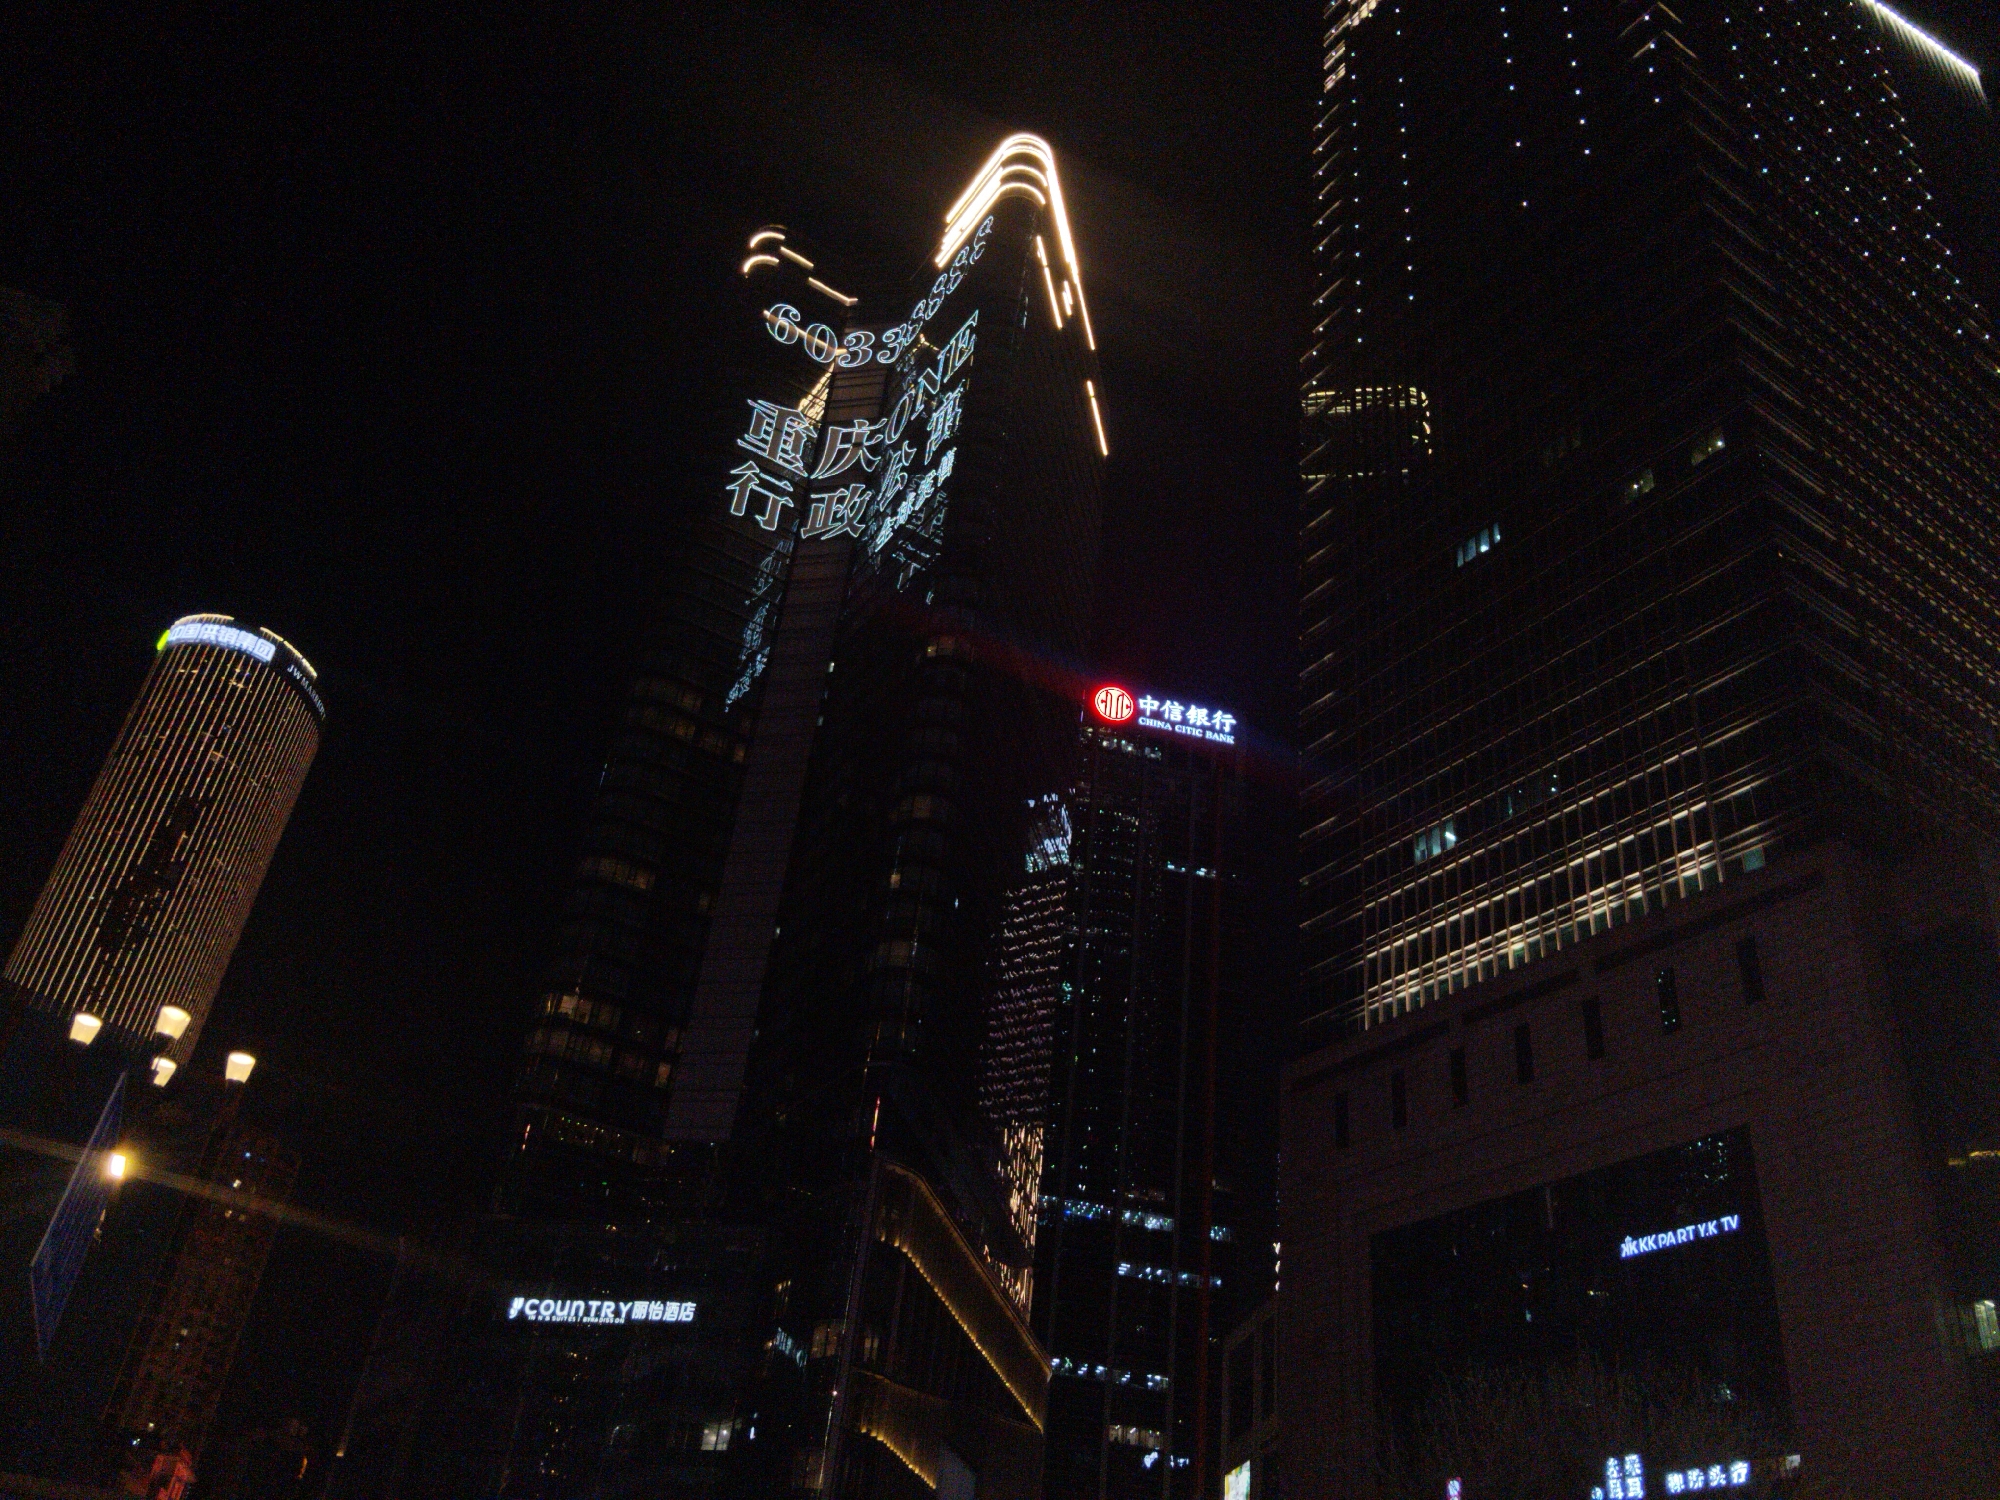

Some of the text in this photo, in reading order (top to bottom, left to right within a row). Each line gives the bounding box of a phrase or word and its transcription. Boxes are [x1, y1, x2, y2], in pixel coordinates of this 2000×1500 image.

[168, 623, 276, 662] 中国供销集团
[287, 664, 303, 680] JW
[1137, 694, 1237, 733] 中信银行
[1138, 717, 1235, 744] CHINA CITIC BANK
